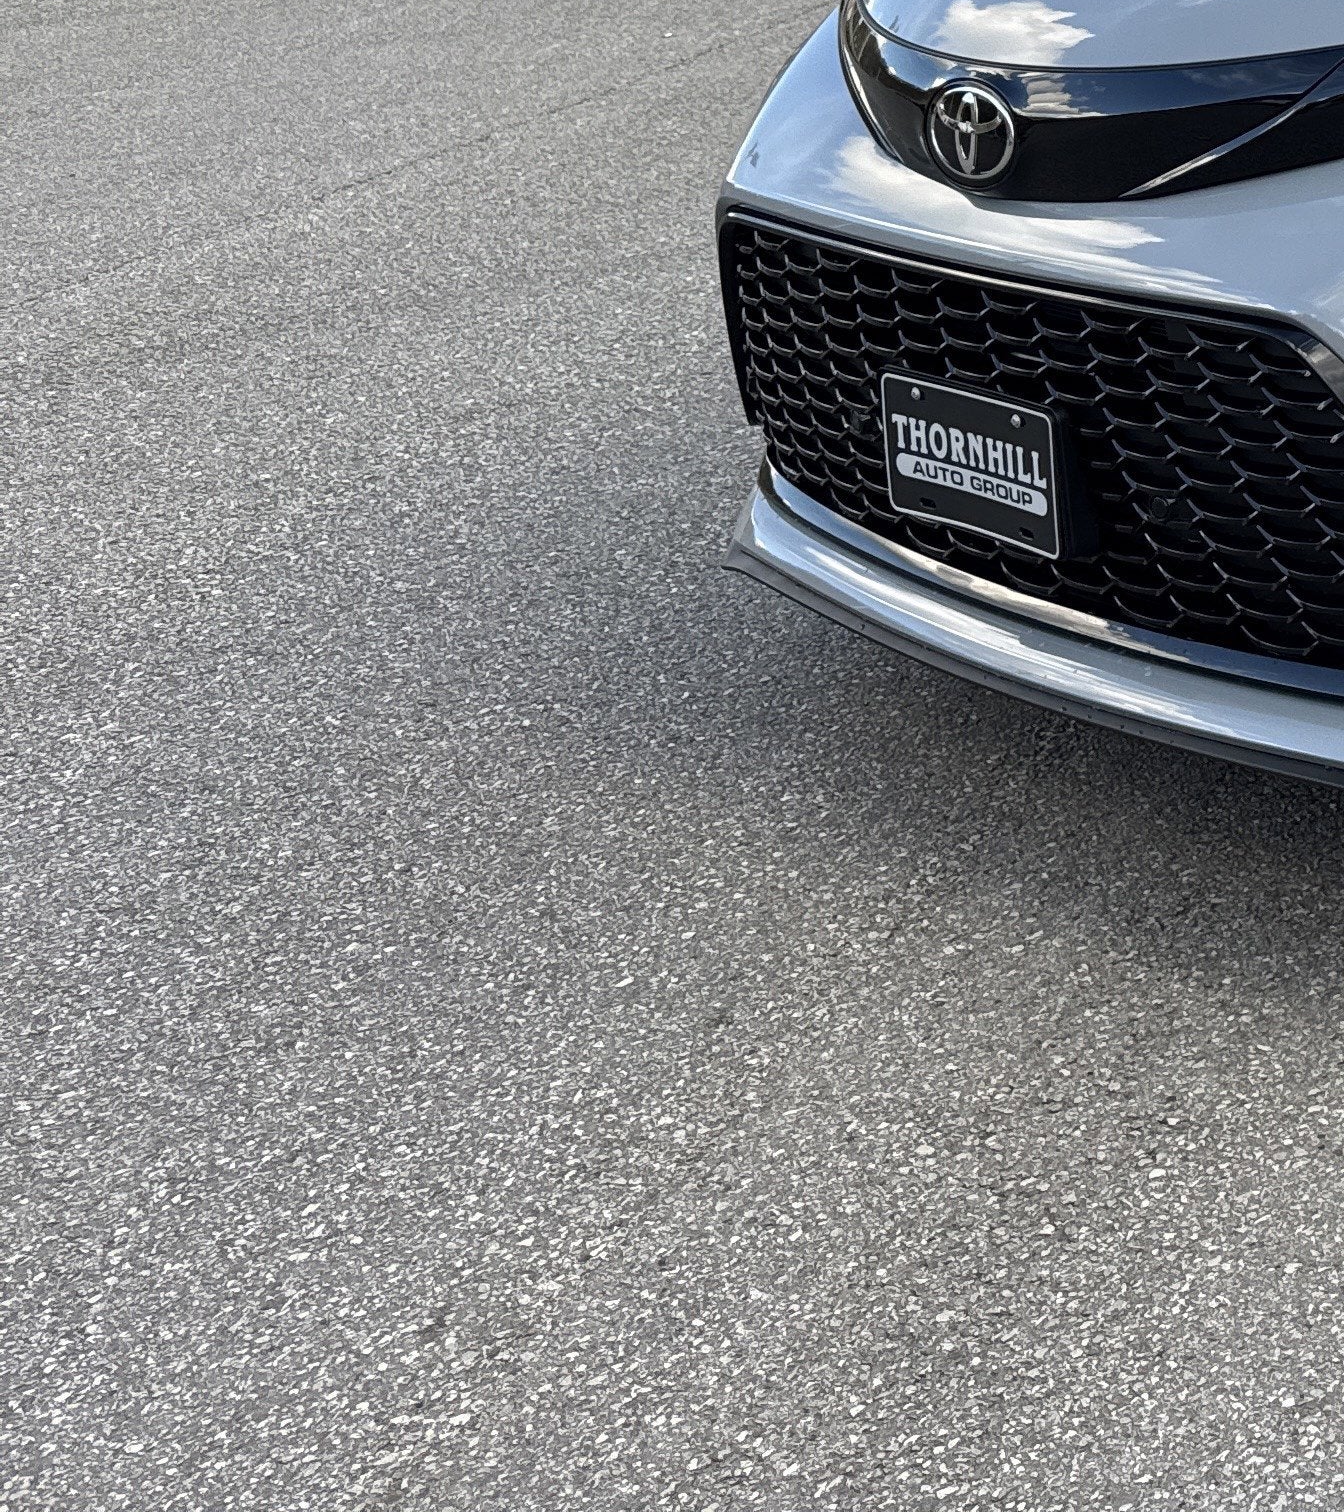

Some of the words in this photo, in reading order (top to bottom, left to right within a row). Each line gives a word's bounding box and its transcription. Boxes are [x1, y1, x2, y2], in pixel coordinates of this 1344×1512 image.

[891, 413, 1047, 489] THORNHILL
[912, 460, 964, 486] AUTO
[970, 476, 1033, 506] GROUP
